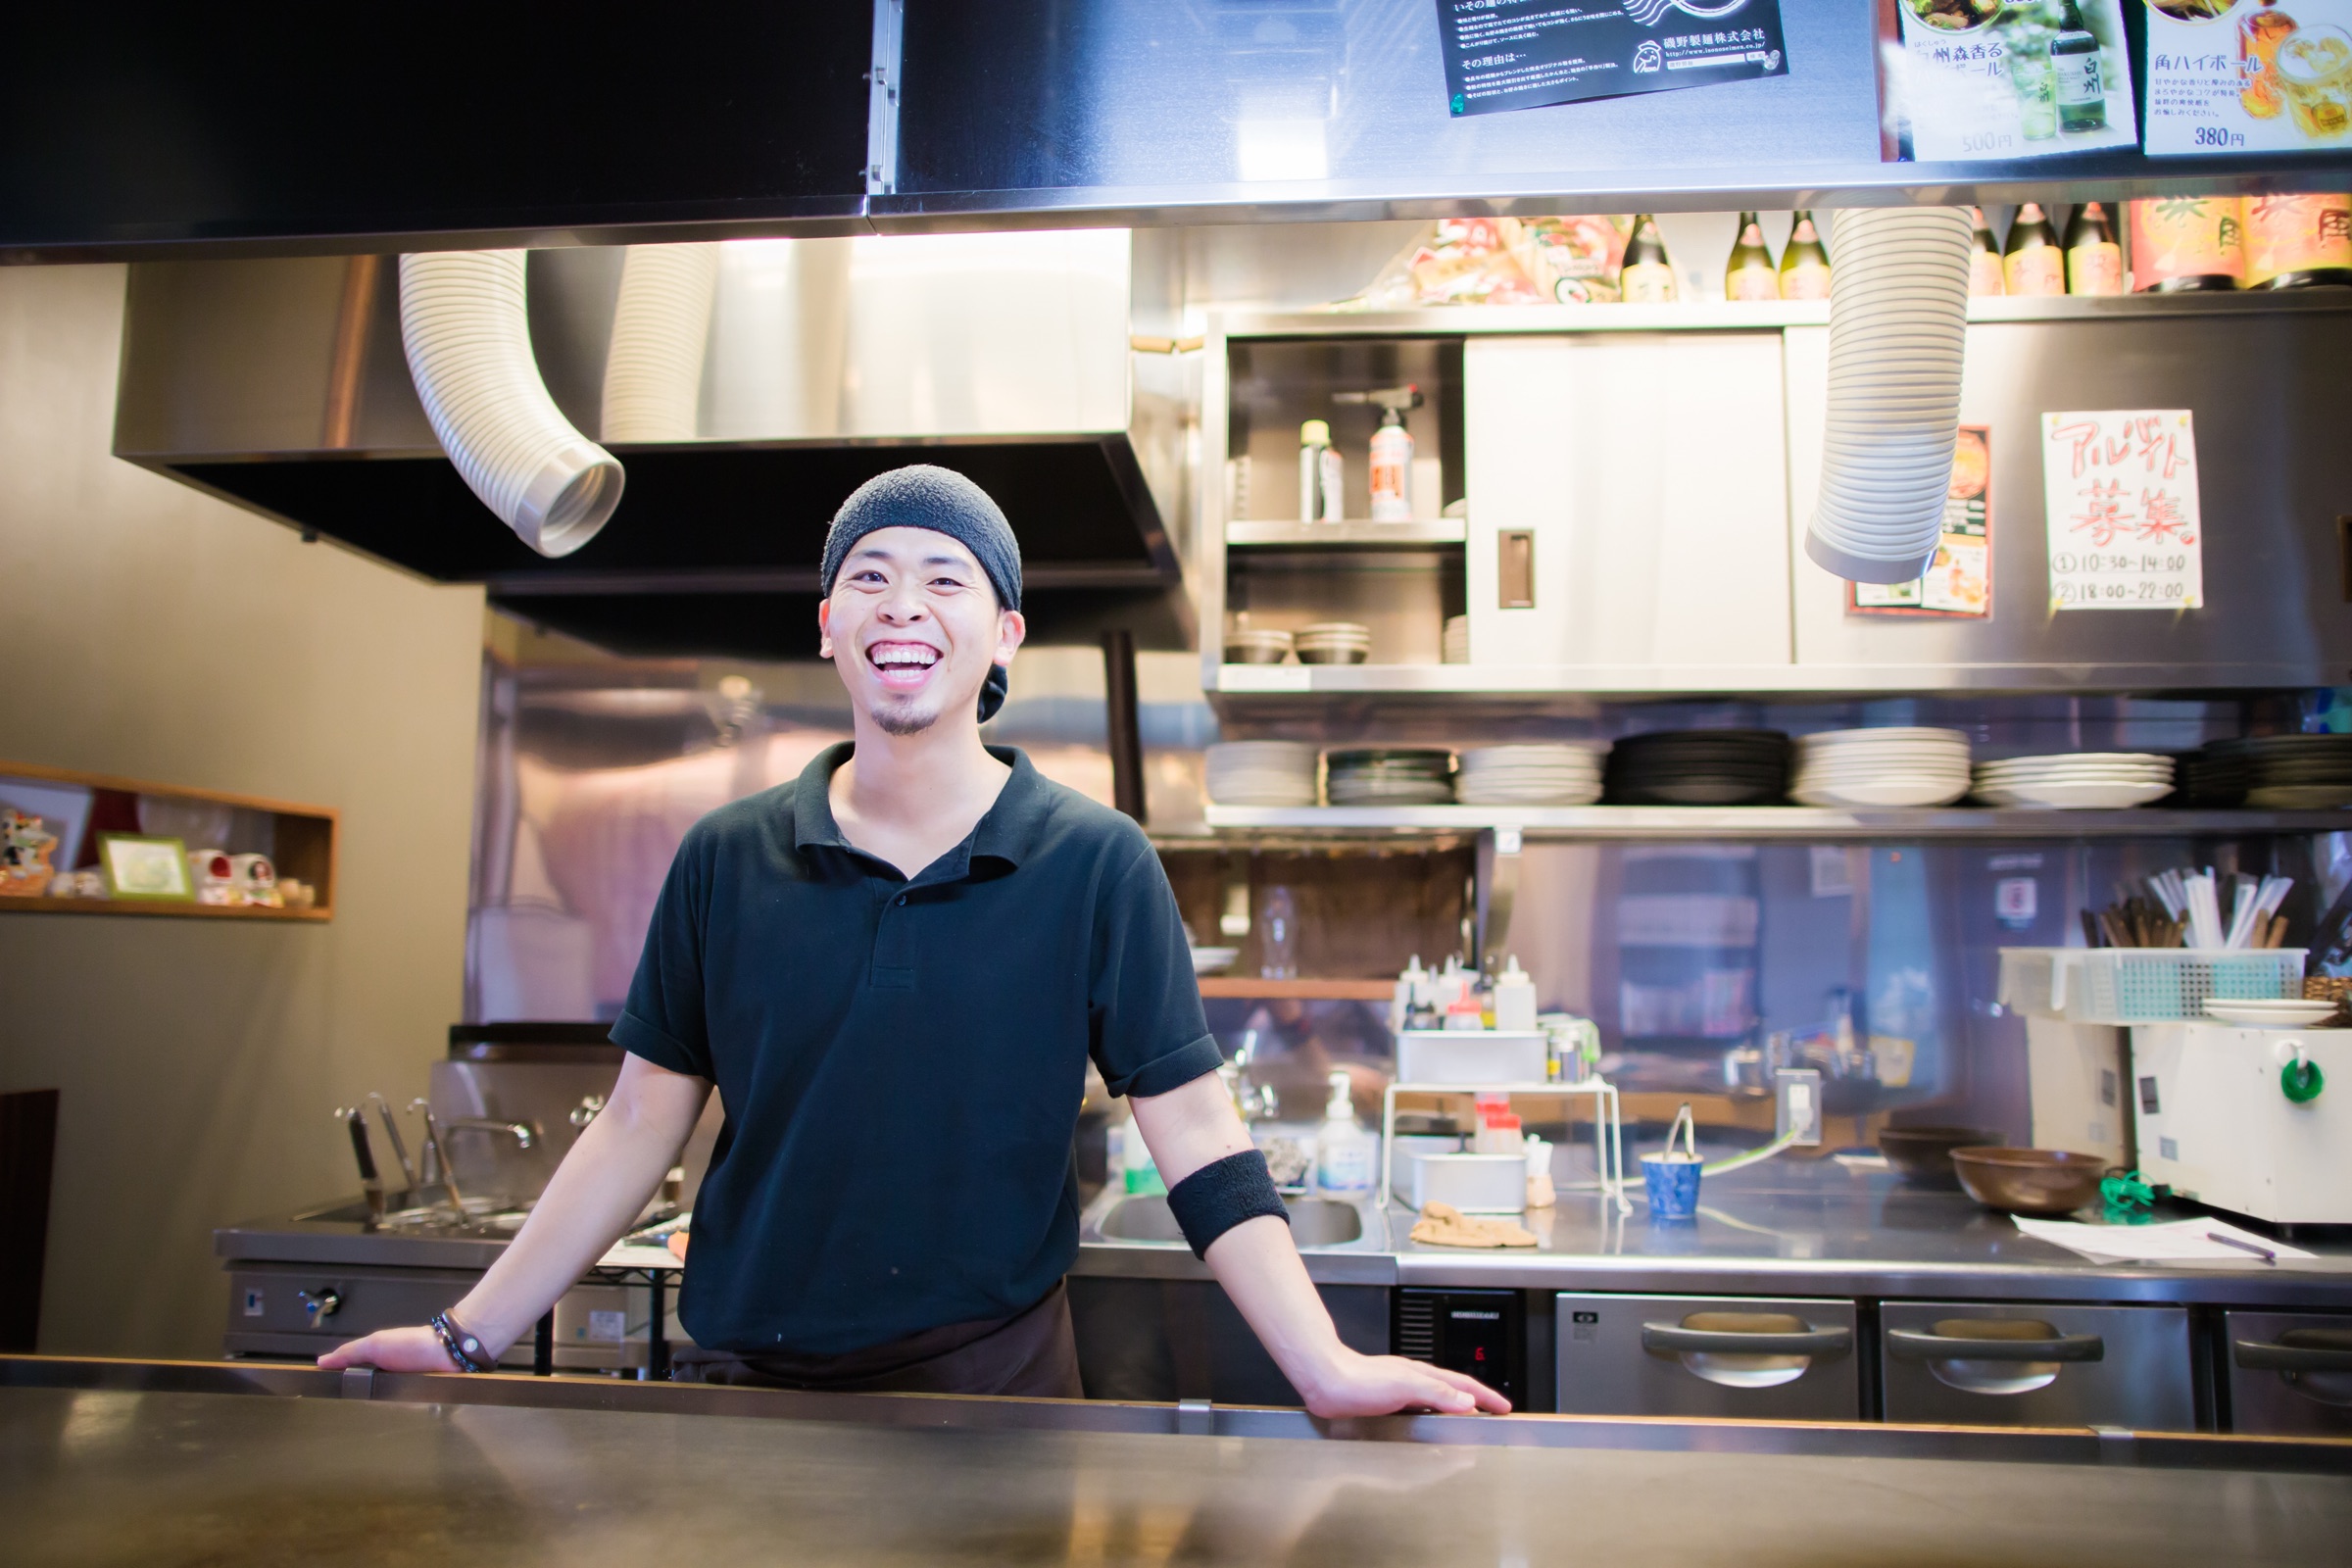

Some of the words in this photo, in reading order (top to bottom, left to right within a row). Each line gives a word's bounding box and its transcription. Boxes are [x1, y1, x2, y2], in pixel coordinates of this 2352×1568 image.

[1663, 28, 1765, 49] 磯野製麺株式会社
[1914, 39, 1946, 48] はくしゅう
[1666, 41, 1765, 58] http://www.isonoseimen.co.jp/
[2155, 55, 2263, 72] 角ハイボール
[2083, 57, 2100, 94] 白州
[1962, 131, 2012, 152] 500円
[2195, 126, 2244, 146] 380円
[2051, 416, 2188, 478] アルバイト
